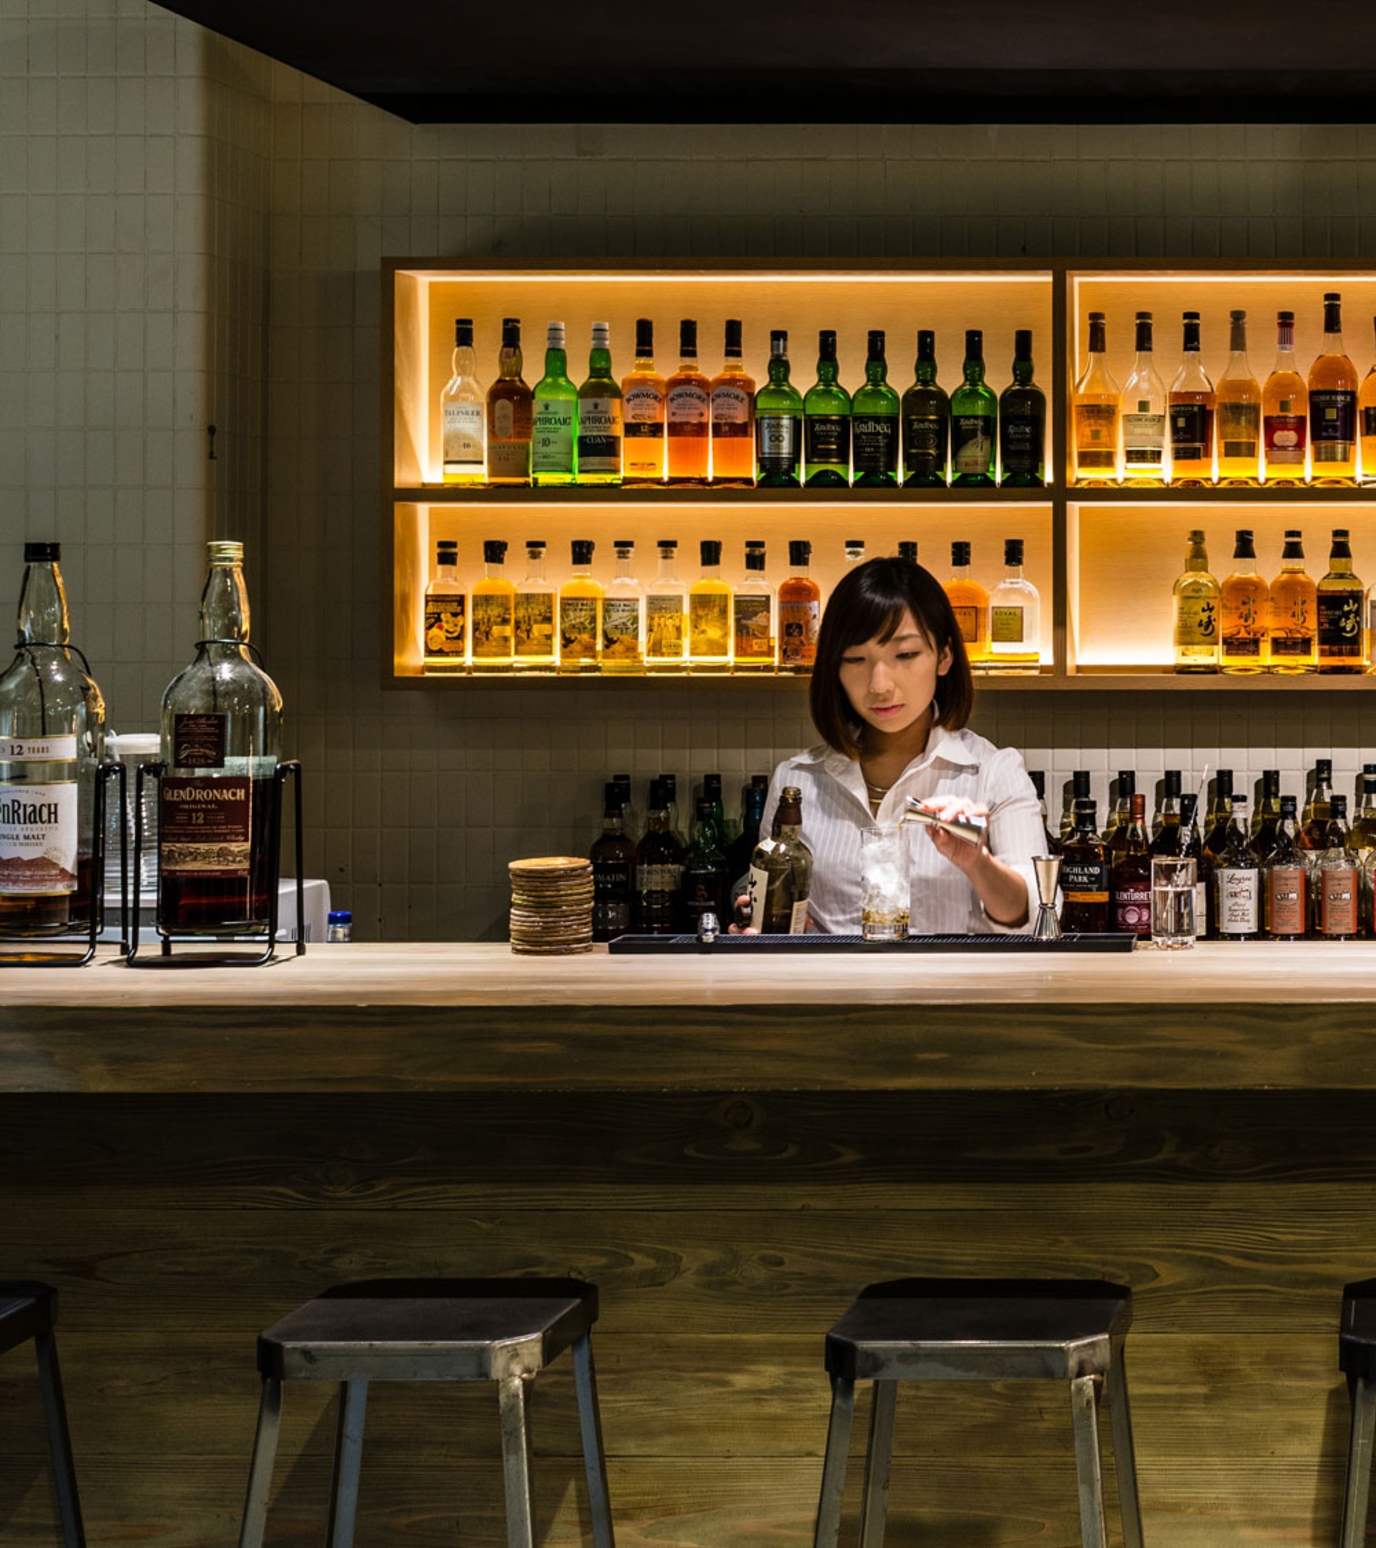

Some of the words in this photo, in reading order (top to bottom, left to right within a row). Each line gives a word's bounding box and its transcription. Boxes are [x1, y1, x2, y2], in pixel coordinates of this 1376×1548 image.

[444, 409, 481, 417] TALISKER
[533, 415, 572, 426] PHROAIG
[541, 437, 551, 447] 10
[1198, 600, 1217, 637] 山崎
[1340, 598, 1361, 638] 山崎
[9, 744, 24, 756] 12
[27, 746, 50, 754] YEARS
[163, 786, 246, 802] GLENDRONACH
[191, 812, 205, 825] 12
[23, 833, 46, 841] MALT
[1062, 866, 1101, 875] HIGHLAND
[593, 872, 627, 883] OMATIN
[1068, 875, 1089, 883] PARK
